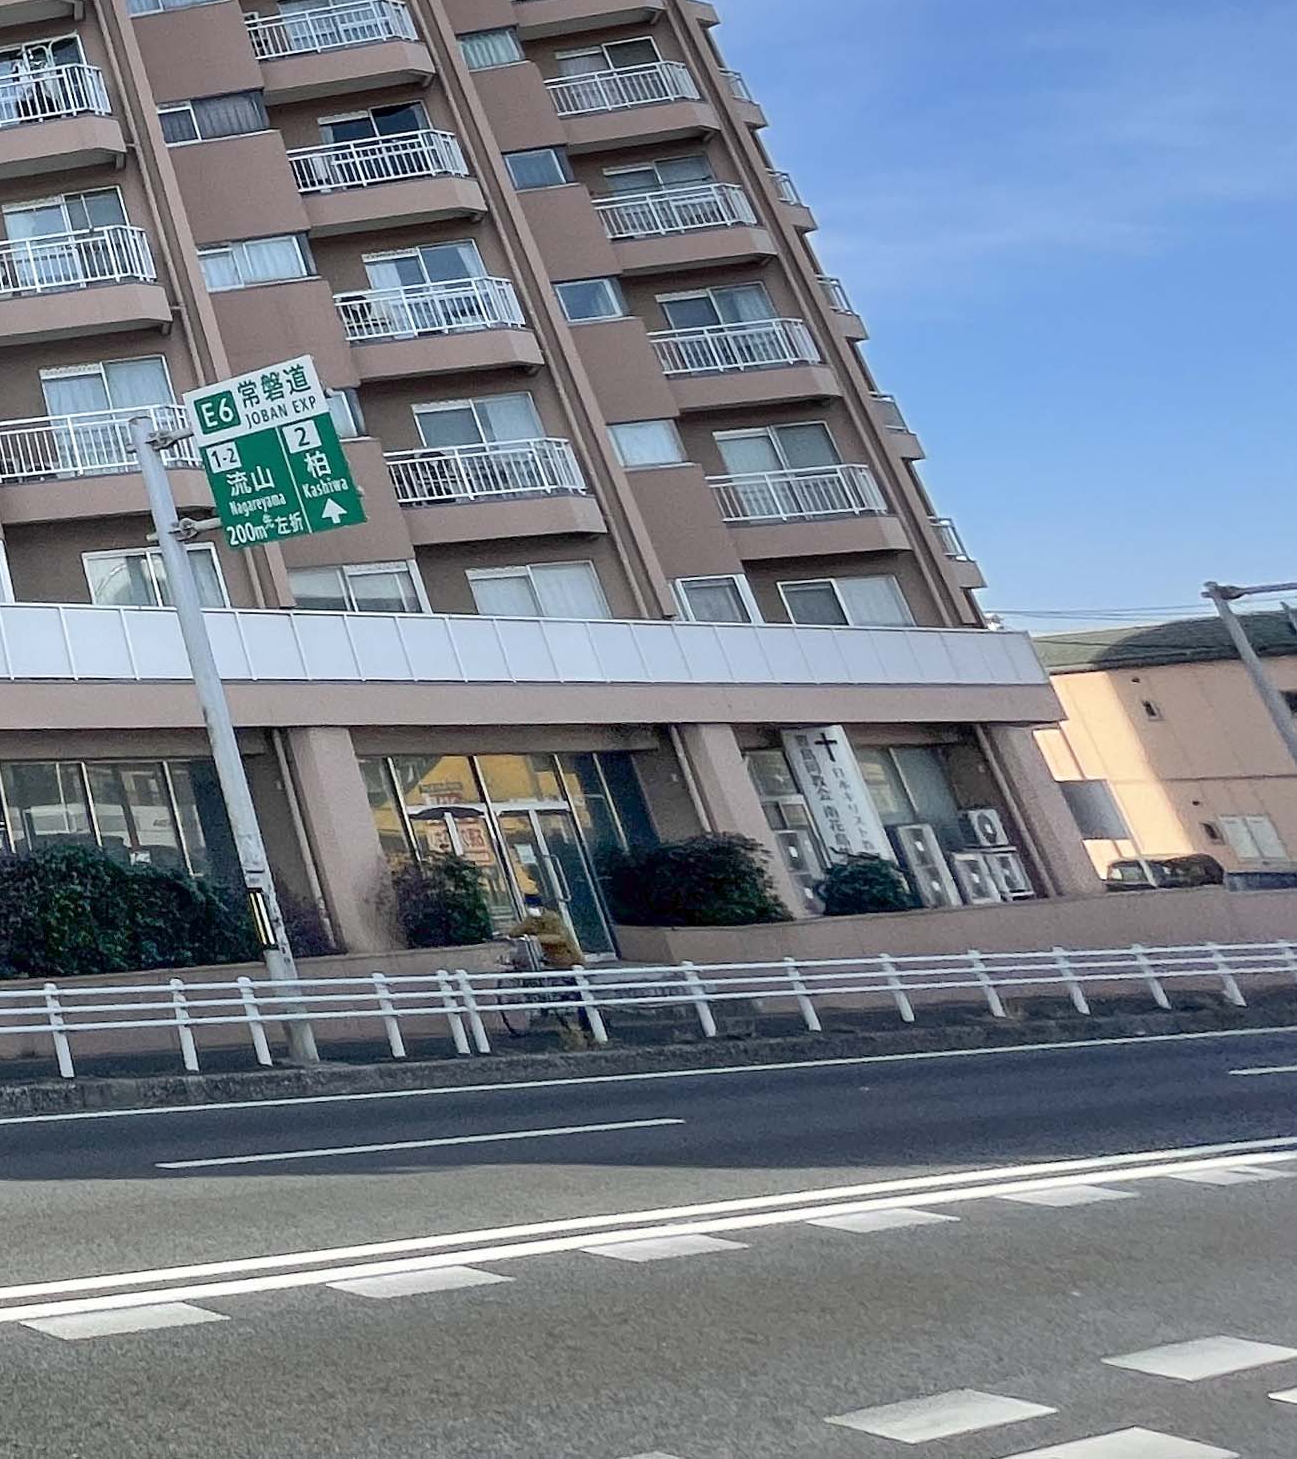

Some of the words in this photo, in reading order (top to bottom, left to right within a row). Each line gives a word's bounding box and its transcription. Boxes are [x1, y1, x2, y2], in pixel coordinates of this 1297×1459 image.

[237, 363, 312, 409] 常磐道
[200, 397, 235, 428] E6
[245, 403, 288, 430] JOBAN
[292, 395, 317, 414] EXP
[293, 426, 311, 447] 2
[210, 448, 238, 469] 1-2
[303, 450, 332, 479] 柏
[226, 465, 276, 497] 流山
[302, 477, 349, 499] Kashiwa
[229, 493, 287, 518] Nagareyama
